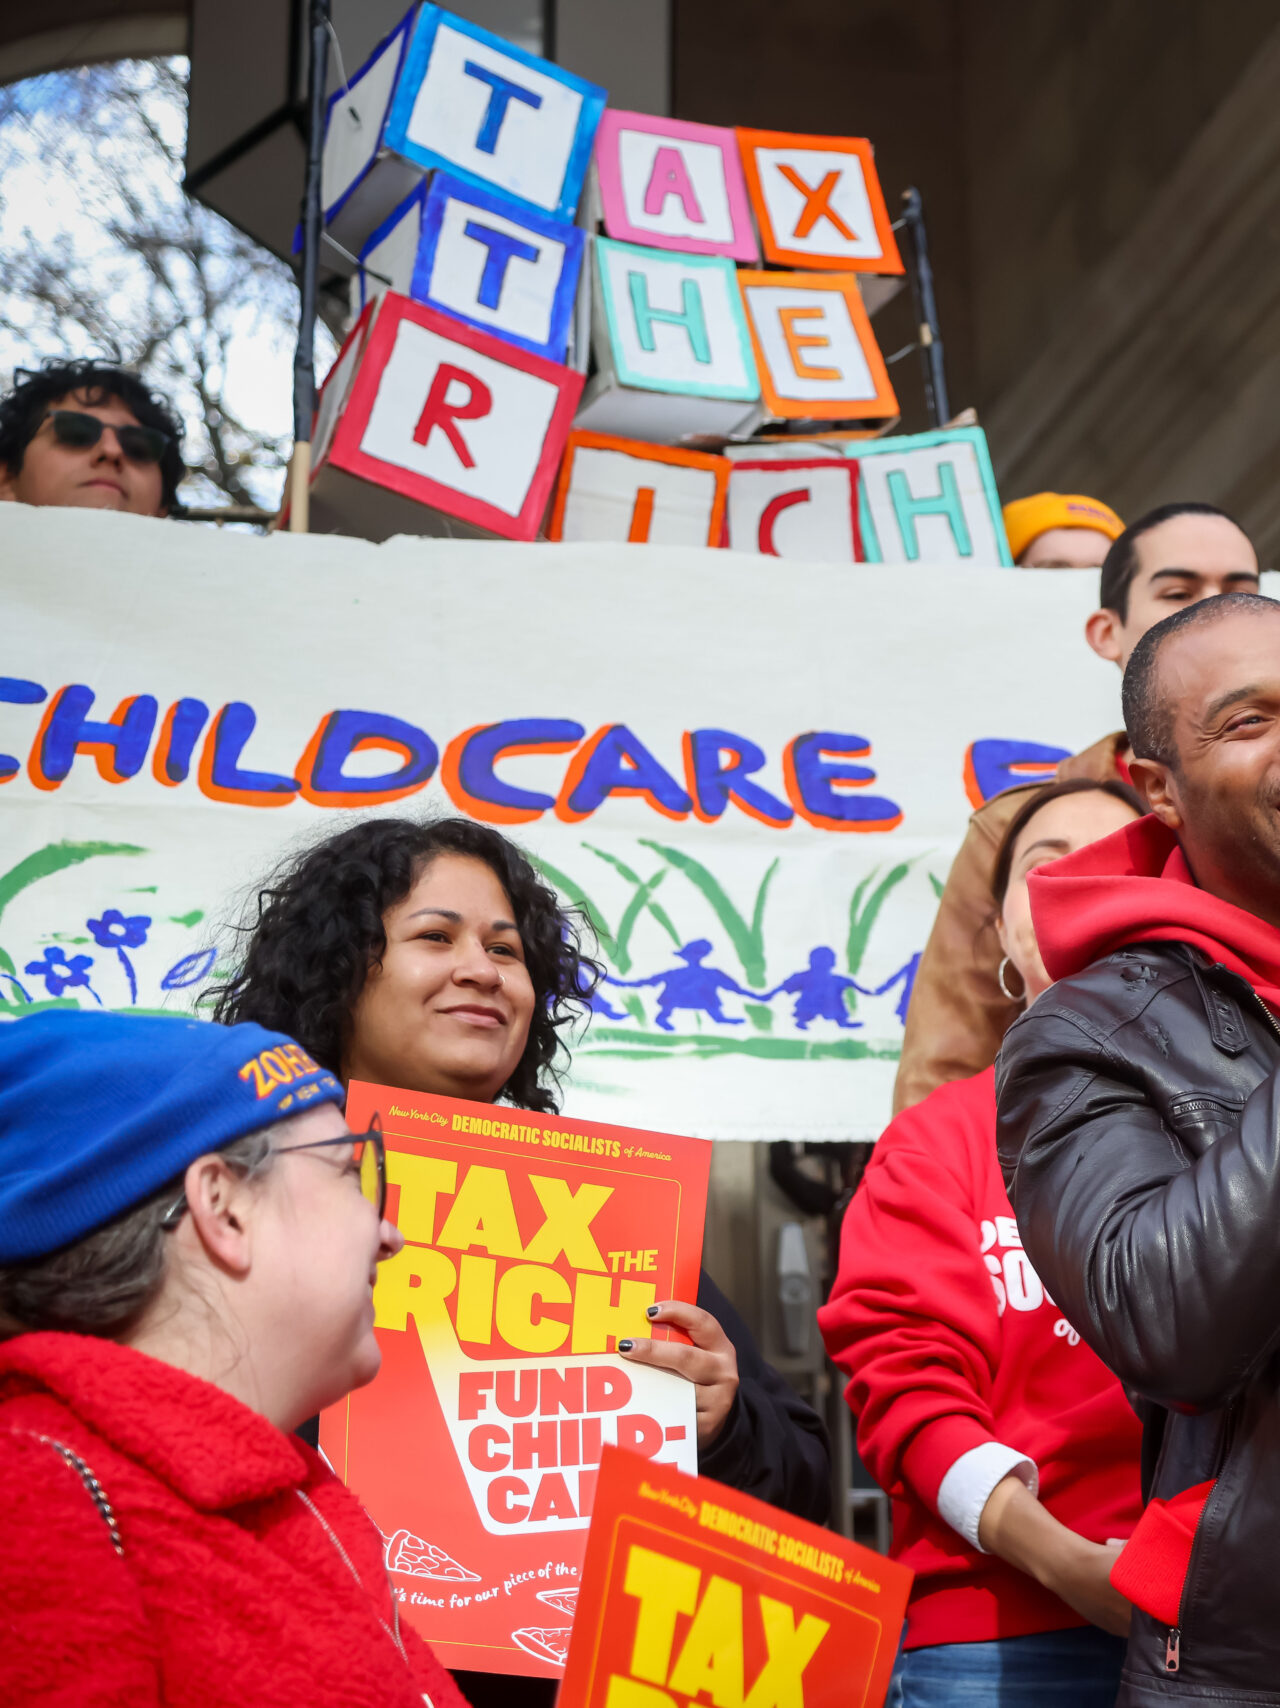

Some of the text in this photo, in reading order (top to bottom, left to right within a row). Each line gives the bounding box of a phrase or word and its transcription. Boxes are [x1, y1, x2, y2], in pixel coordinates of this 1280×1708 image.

[464, 59, 858, 241] TAX
[464, 220, 843, 380] THE
[413, 362, 974, 561] RICH
[388, 1105, 672, 1161] New York City DEMOCRATIC SOCIALISTS of America
[380, 1148, 615, 1273] TAX
[607, 1249, 659, 1273] THE
[372, 1244, 657, 1354] RICH
[458, 1366, 633, 1420] FUND
[410, 1592, 445, 1608] time
[449, 1593, 472, 1609] for
[475, 1586, 500, 1602] our
[503, 1569, 536, 1596] piece
[537, 1561, 553, 1578] of
[555, 1561, 578, 1576] the
[699, 1500, 779, 1556] DEMOCRATIC
[777, 1533, 845, 1584] SOCIALISTS
[623, 1543, 832, 1708] TAX
